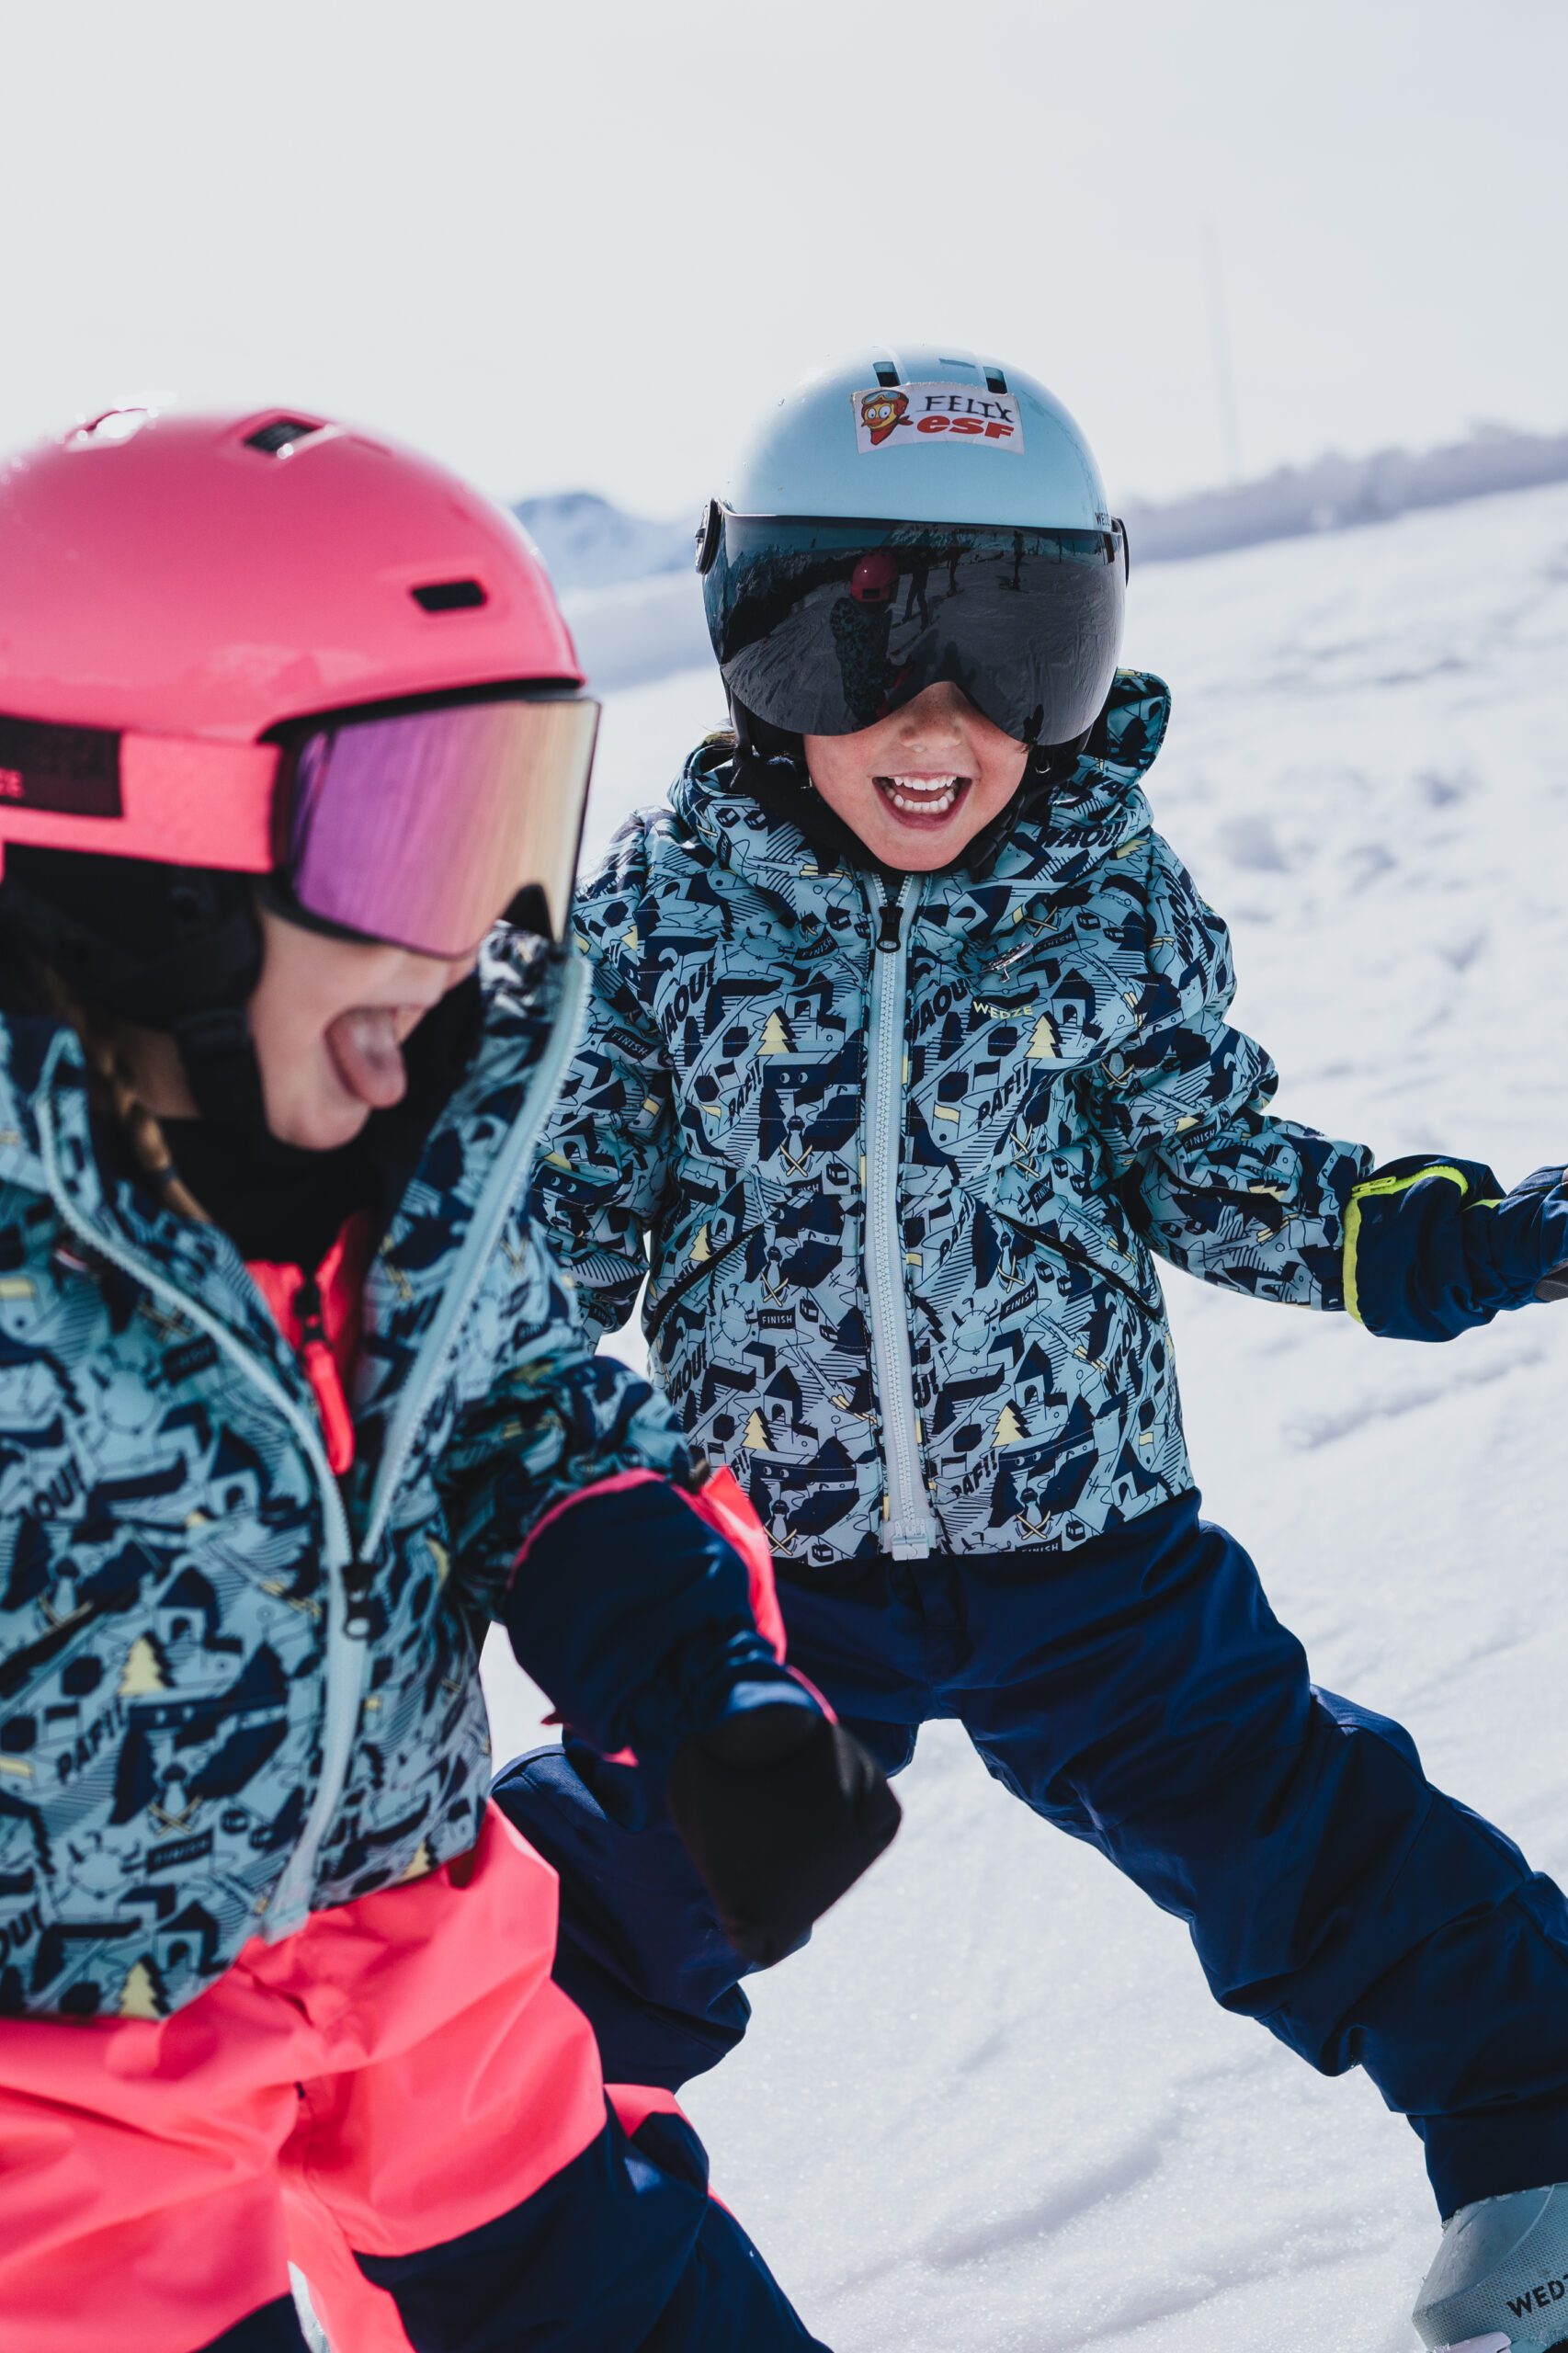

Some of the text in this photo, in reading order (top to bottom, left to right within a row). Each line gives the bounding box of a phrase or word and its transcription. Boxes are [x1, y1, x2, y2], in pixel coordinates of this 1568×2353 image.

[924, 395, 1015, 423] FELIX
[972, 1001, 1033, 1020] WEDZE
[611, 1031, 648, 1056] FINISH
[1184, 1130, 1215, 1149] FINISH
[1005, 1288, 1037, 1314] FINISH
[762, 1314, 792, 1324] FINISH
[1506, 2273, 1568, 2319] WED
